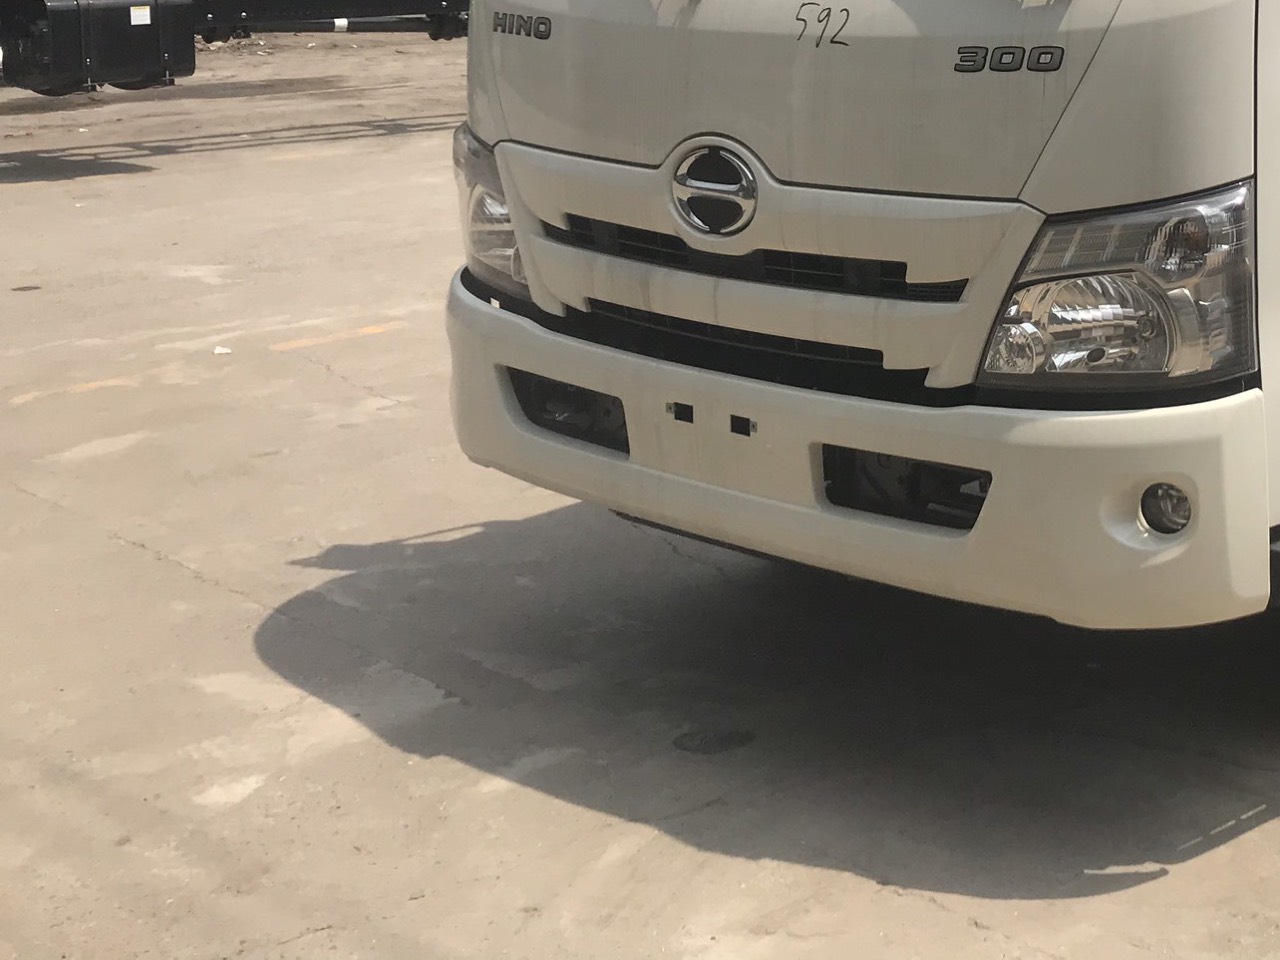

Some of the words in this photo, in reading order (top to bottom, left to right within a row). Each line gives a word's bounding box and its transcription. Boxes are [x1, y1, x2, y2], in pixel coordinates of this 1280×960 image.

[493, 11, 552, 40] HINO
[795, 2, 850, 48] 592
[954, 46, 1064, 73] 300
